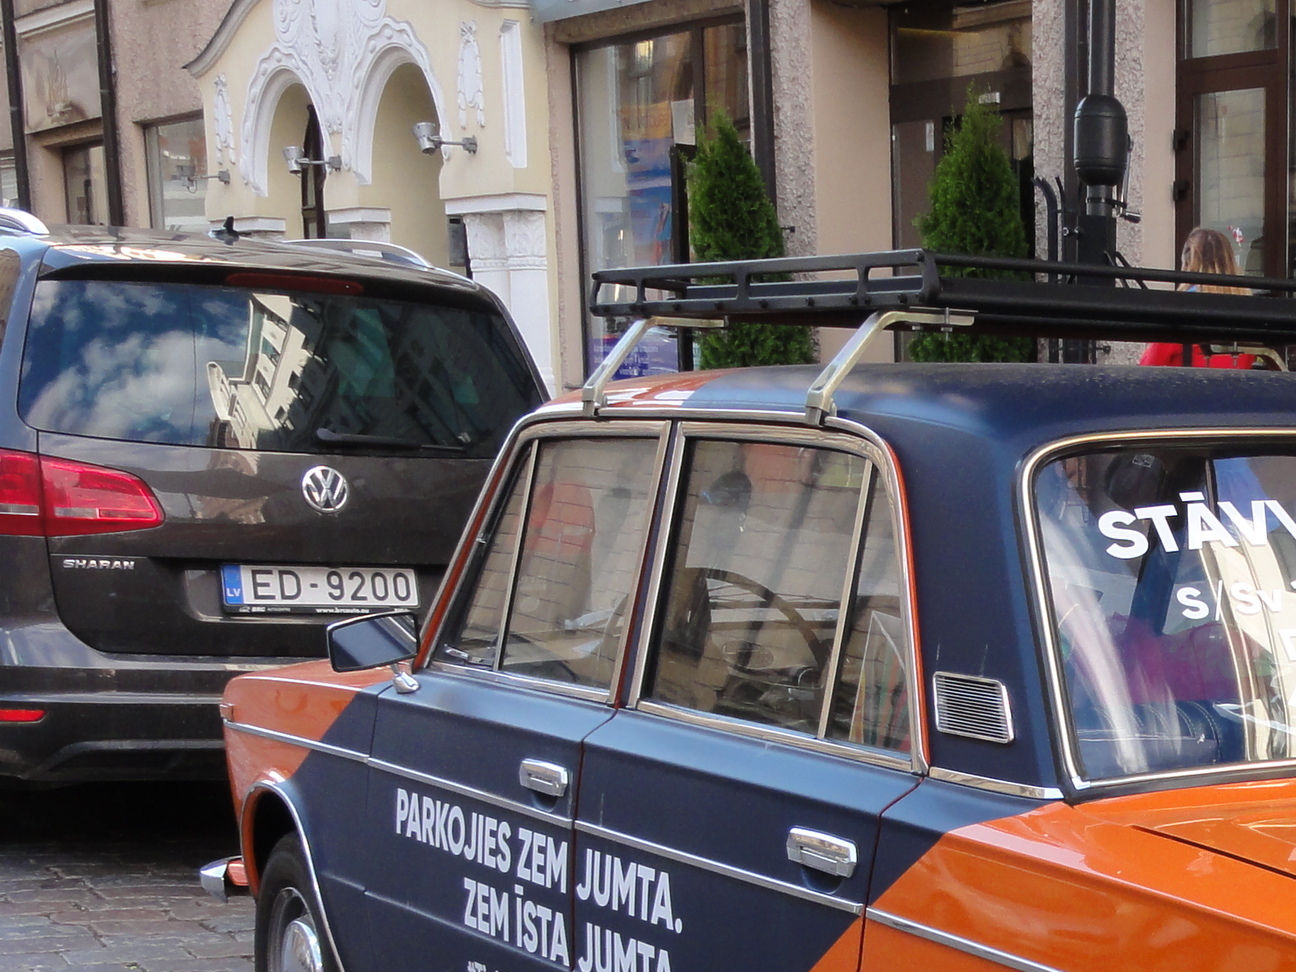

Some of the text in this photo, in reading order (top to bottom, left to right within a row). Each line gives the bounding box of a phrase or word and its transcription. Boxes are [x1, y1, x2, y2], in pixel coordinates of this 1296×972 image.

[62, 559, 135, 571] SHARAN
[226, 587, 241, 597] LV
[395, 787, 683, 934] PARKOJIES ZEM JUMTA.
[463, 876, 510, 942] ZEM
[513, 883, 571, 967] ĪSTA
